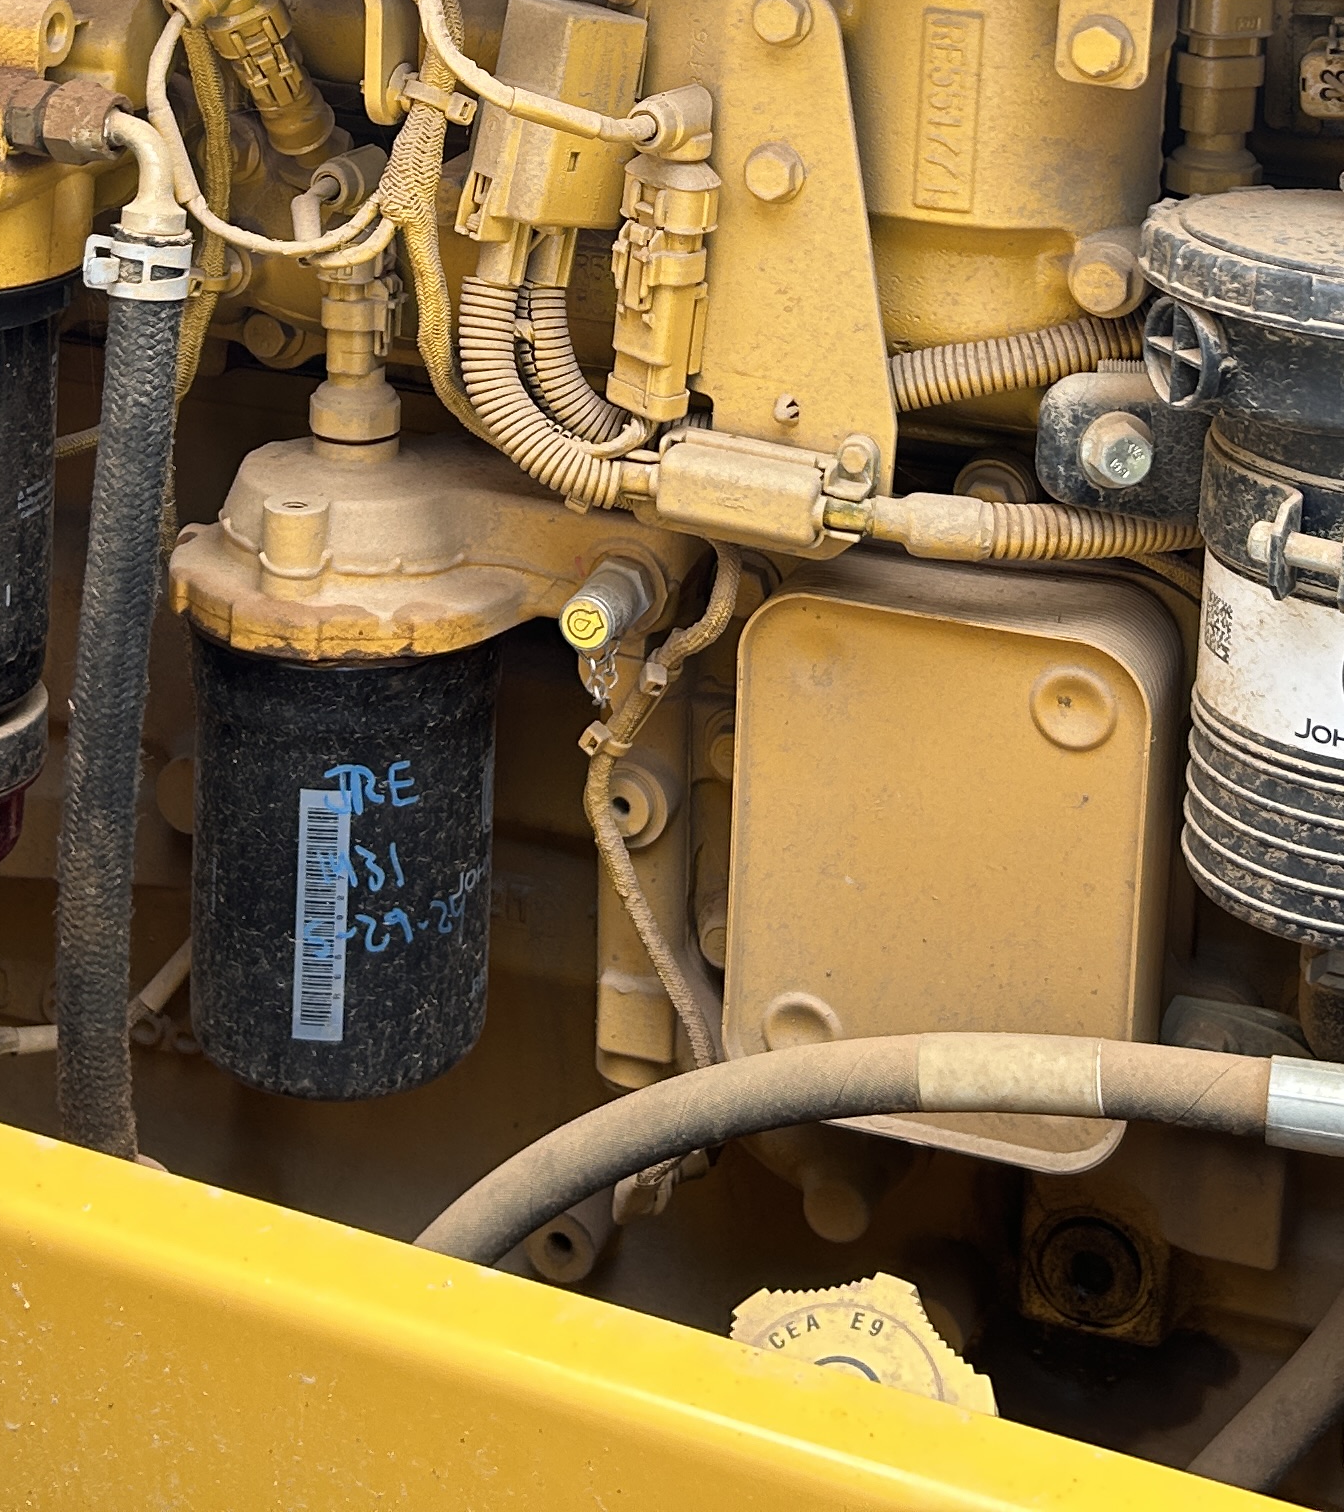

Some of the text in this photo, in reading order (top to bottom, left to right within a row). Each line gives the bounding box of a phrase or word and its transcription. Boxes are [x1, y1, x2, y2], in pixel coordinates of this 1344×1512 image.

[323, 759, 421, 816] JRE
[767, 1311, 885, 1351] CEA E9
